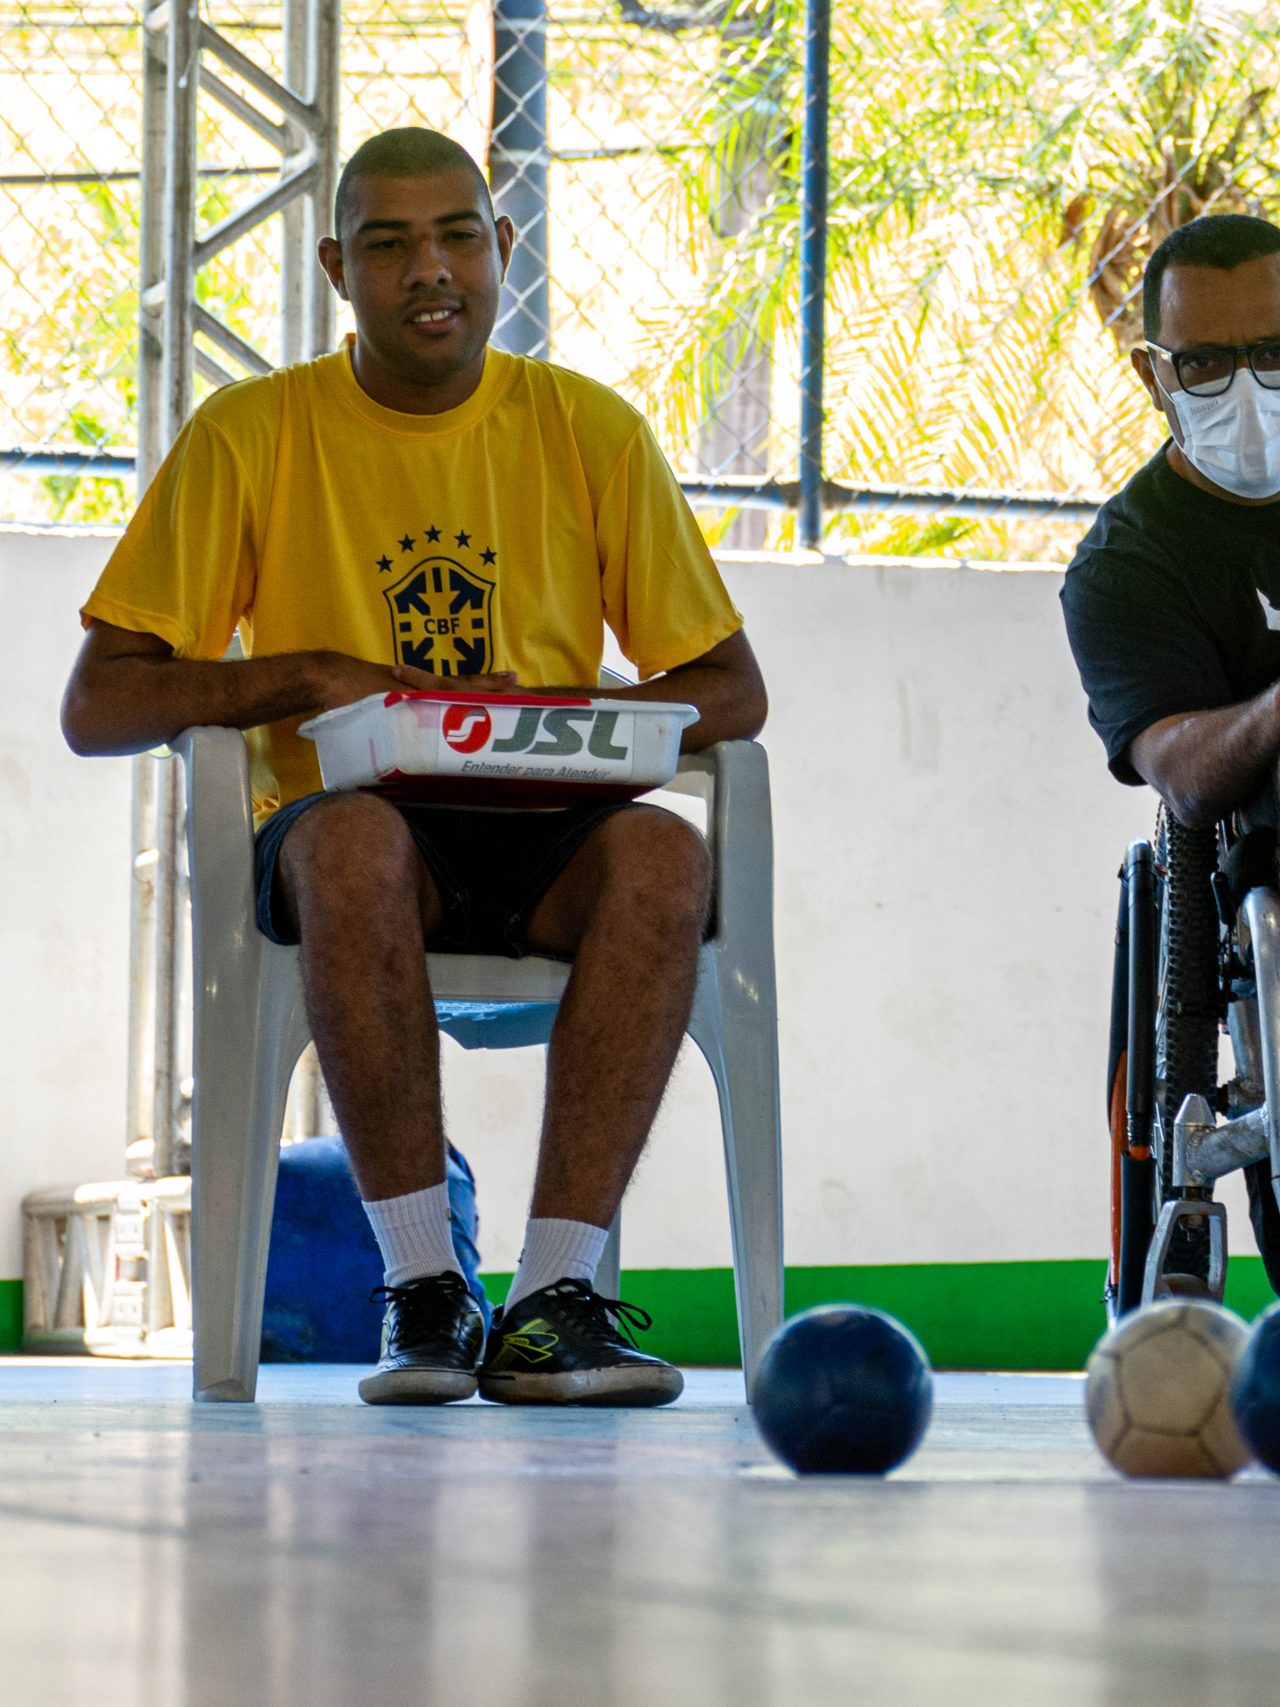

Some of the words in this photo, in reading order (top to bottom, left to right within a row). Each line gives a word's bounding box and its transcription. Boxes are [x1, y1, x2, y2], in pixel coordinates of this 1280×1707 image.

[424, 618, 460, 635] CBF
[491, 707, 628, 760] JSL
[461, 760, 523, 776] Entender
[523, 766, 555, 777] para
